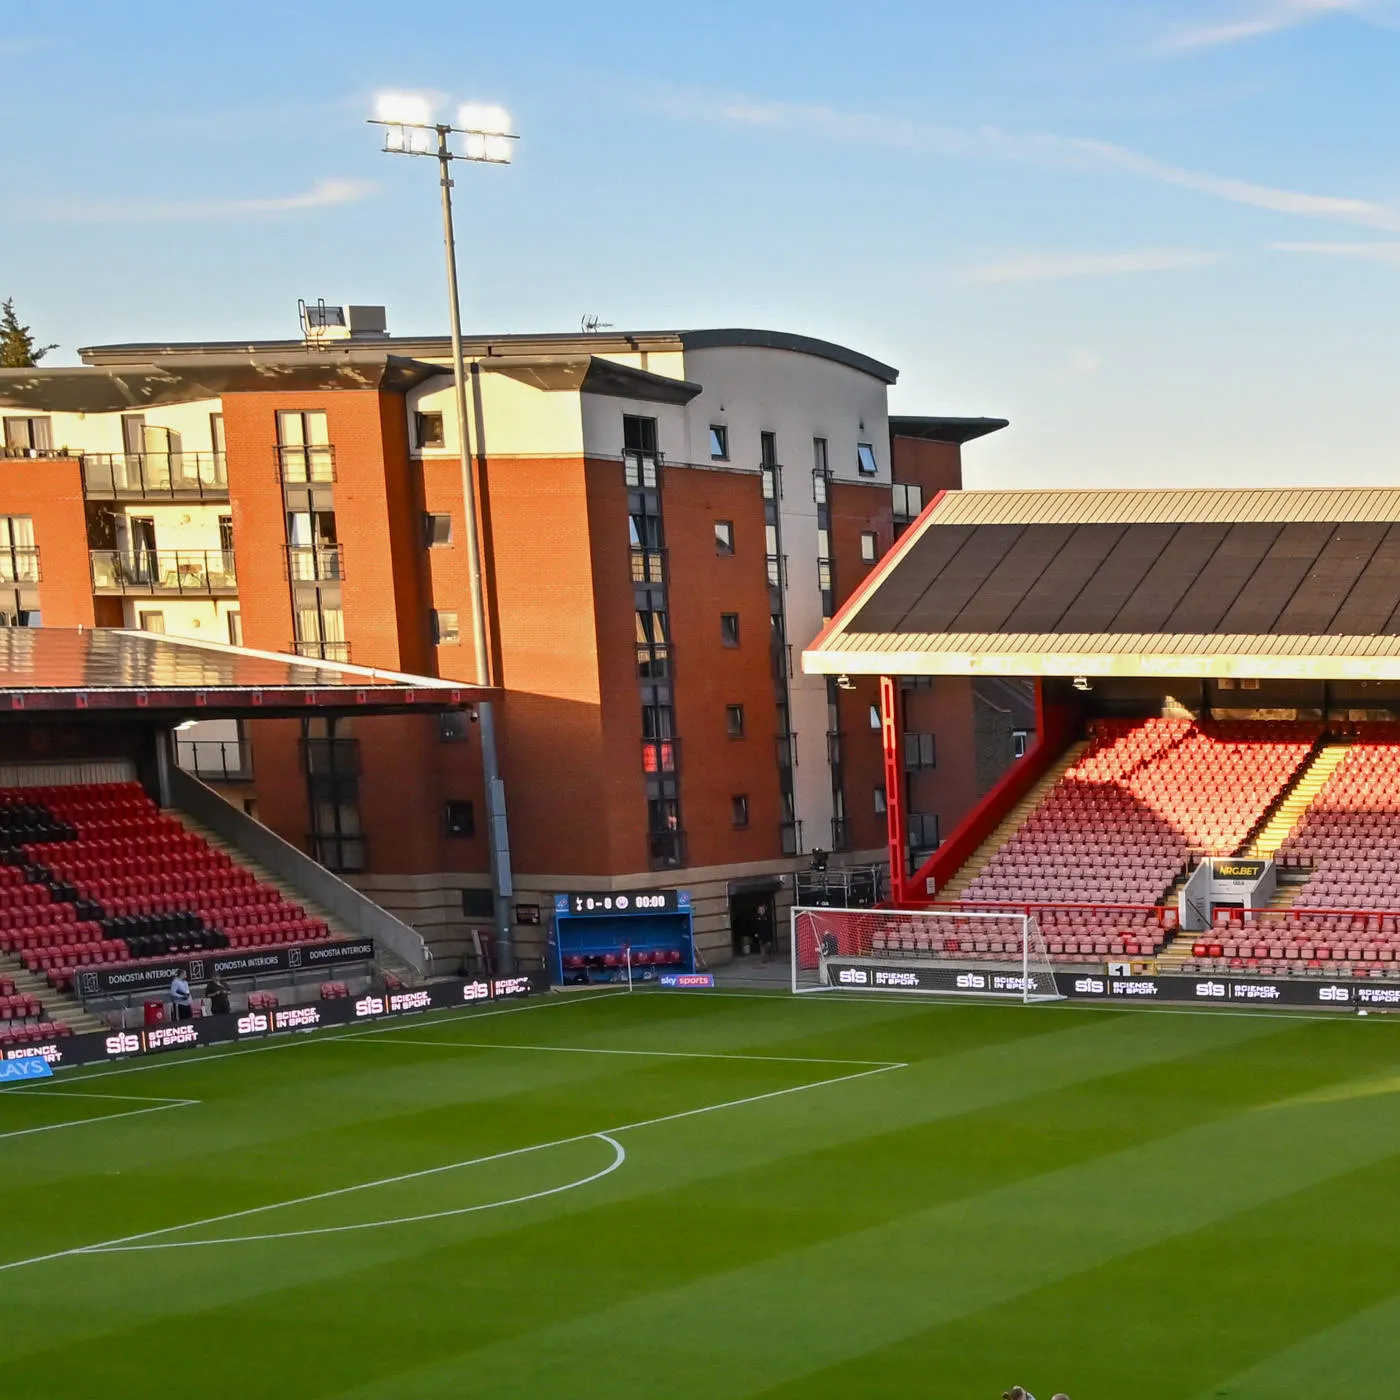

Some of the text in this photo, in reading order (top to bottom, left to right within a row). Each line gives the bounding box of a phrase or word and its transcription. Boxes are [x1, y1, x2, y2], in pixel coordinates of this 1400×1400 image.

[309, 945, 372, 960] DONOSTIA INTERIORS
[214, 955, 279, 972] DONOSTIA INTERIORS
[108, 971, 144, 985] DONOSTIA
[661, 976, 709, 987] sky sports
[1113, 981, 1155, 990] SCIENCE
[1113, 987, 1159, 996] IN SPORT
[1234, 985, 1276, 994] SCIENCE
[390, 991, 428, 1005] SCIENCE
[1235, 990, 1281, 999] IN SPORT
[391, 996, 432, 1011] IN SPORT
[276, 1007, 317, 1022] SCIENCE
[276, 1013, 321, 1029] IN SPORT
[148, 1024, 195, 1042] SCIENCE
[149, 1032, 200, 1049] IN SPORT
